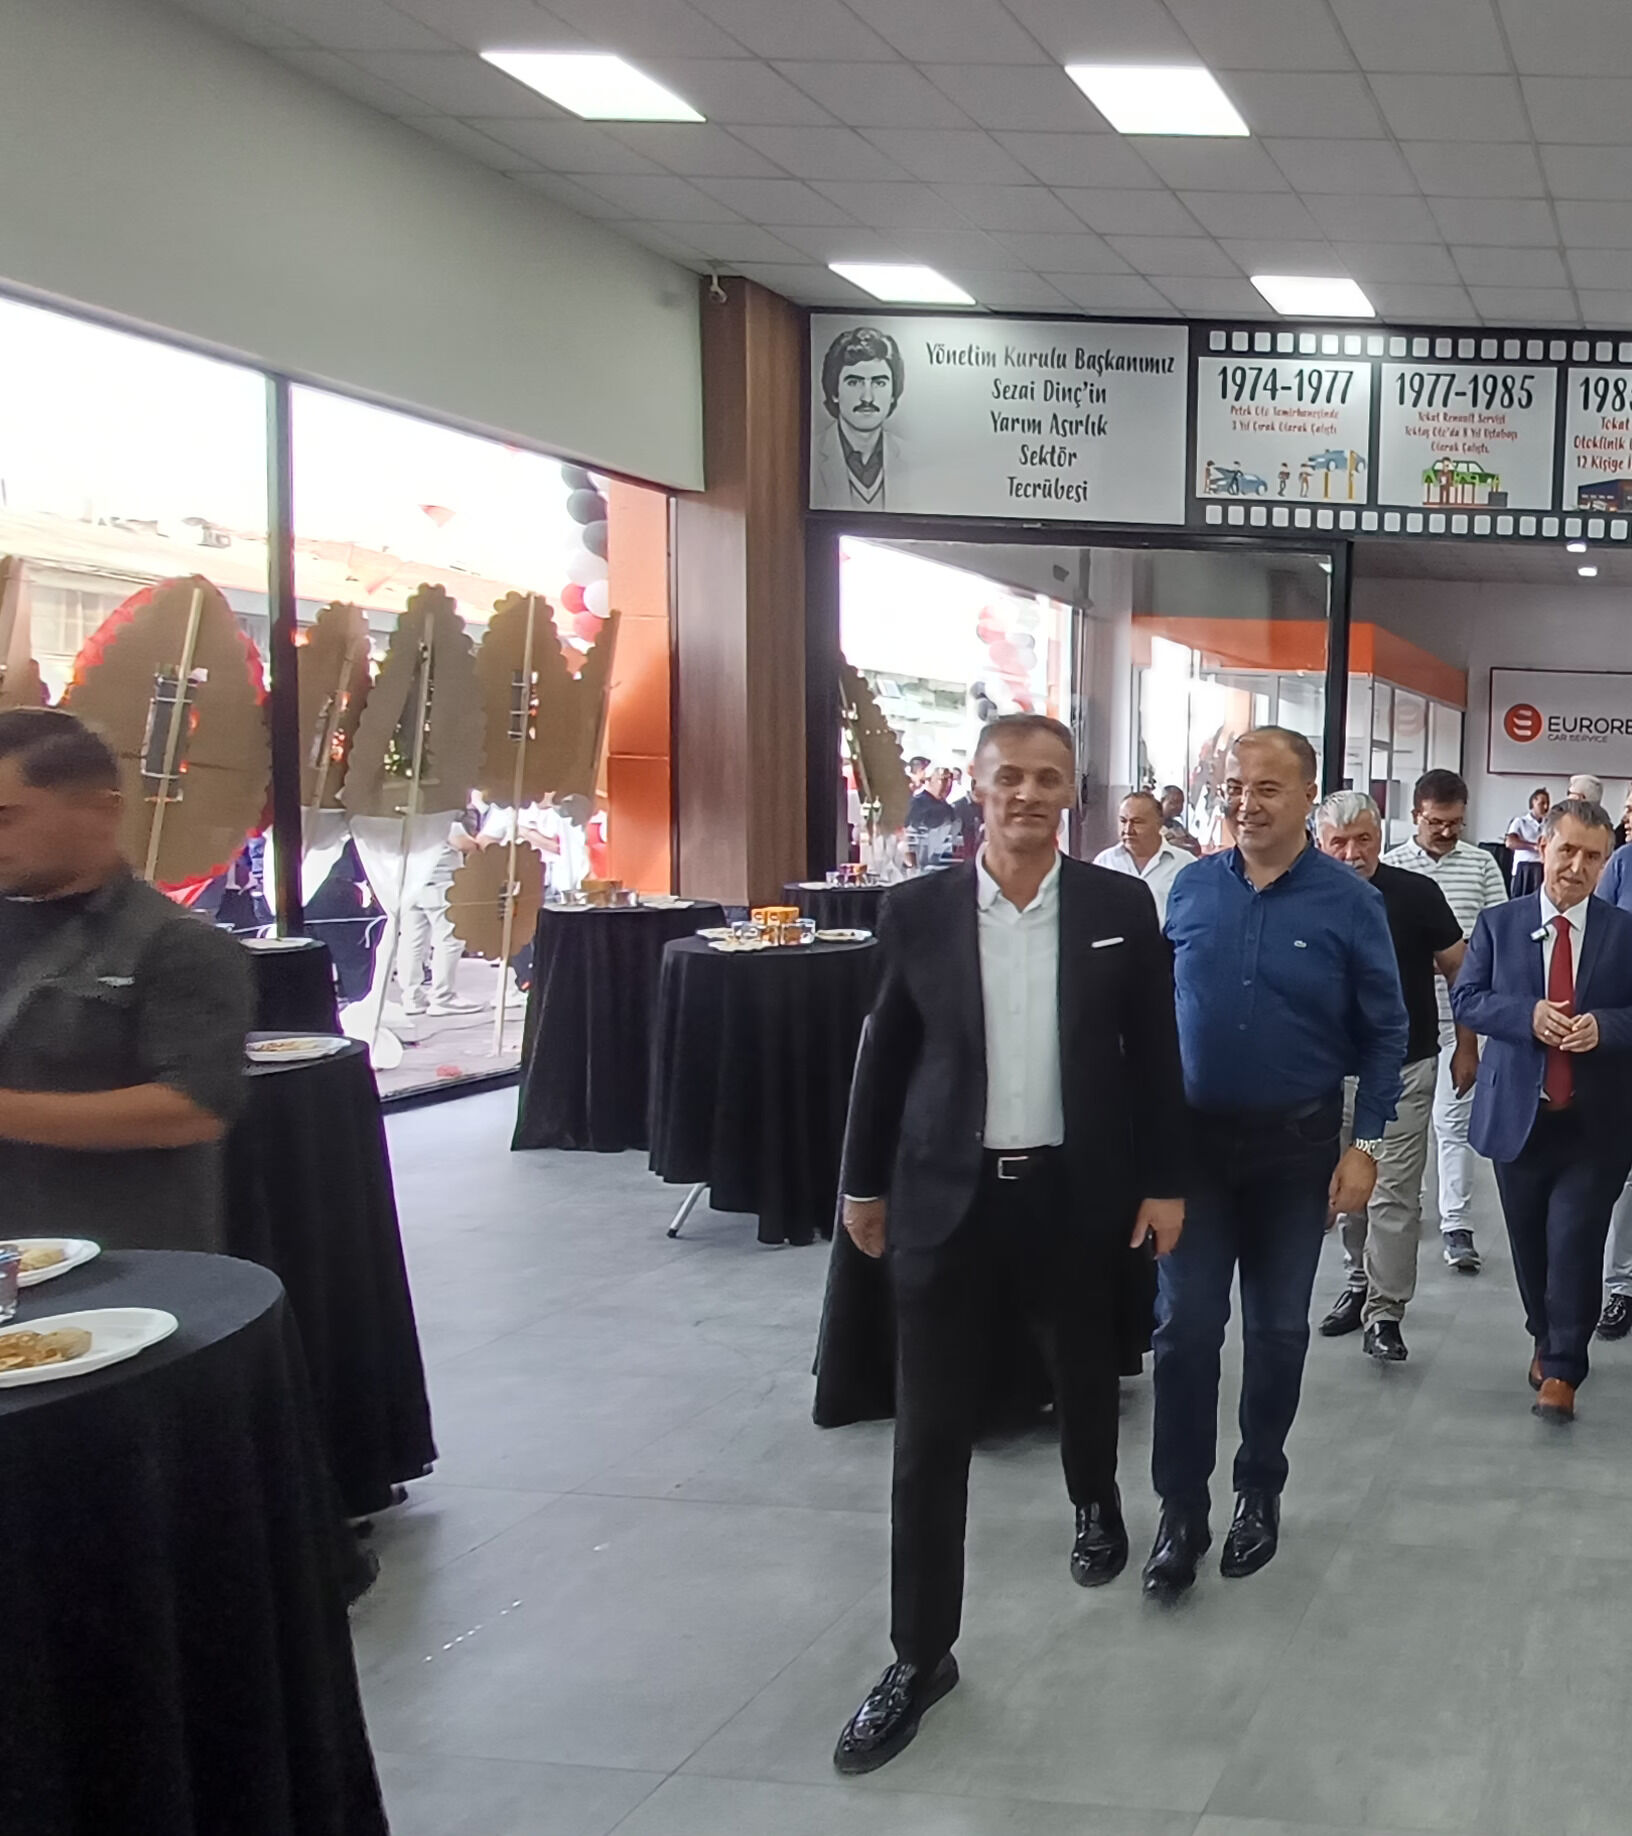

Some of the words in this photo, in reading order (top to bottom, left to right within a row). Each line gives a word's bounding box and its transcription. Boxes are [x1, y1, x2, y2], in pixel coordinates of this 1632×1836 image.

[926, 342, 996, 367] Yönetim
[1005, 346, 1066, 368] Kurulu
[1075, 348, 1175, 377] Başkanımız
[992, 379, 1035, 400] Sezai
[1043, 380, 1106, 408] Dinç'in
[1218, 366, 1353, 404] 1974-1977
[1396, 372, 1535, 410] 1977-1985
[991, 411, 1042, 434] Yarım
[1601, 416, 1629, 430] Tokat
[1574, 435, 1625, 450] Otoklinik
[1019, 444, 1077, 467] Sektör
[1577, 456, 1587, 468] 12
[1591, 456, 1623, 473] Kişiye
[1008, 477, 1088, 503] Tecrübesi
[1547, 734, 1567, 742] CAR
[1569, 735, 1608, 743] SERVICE
